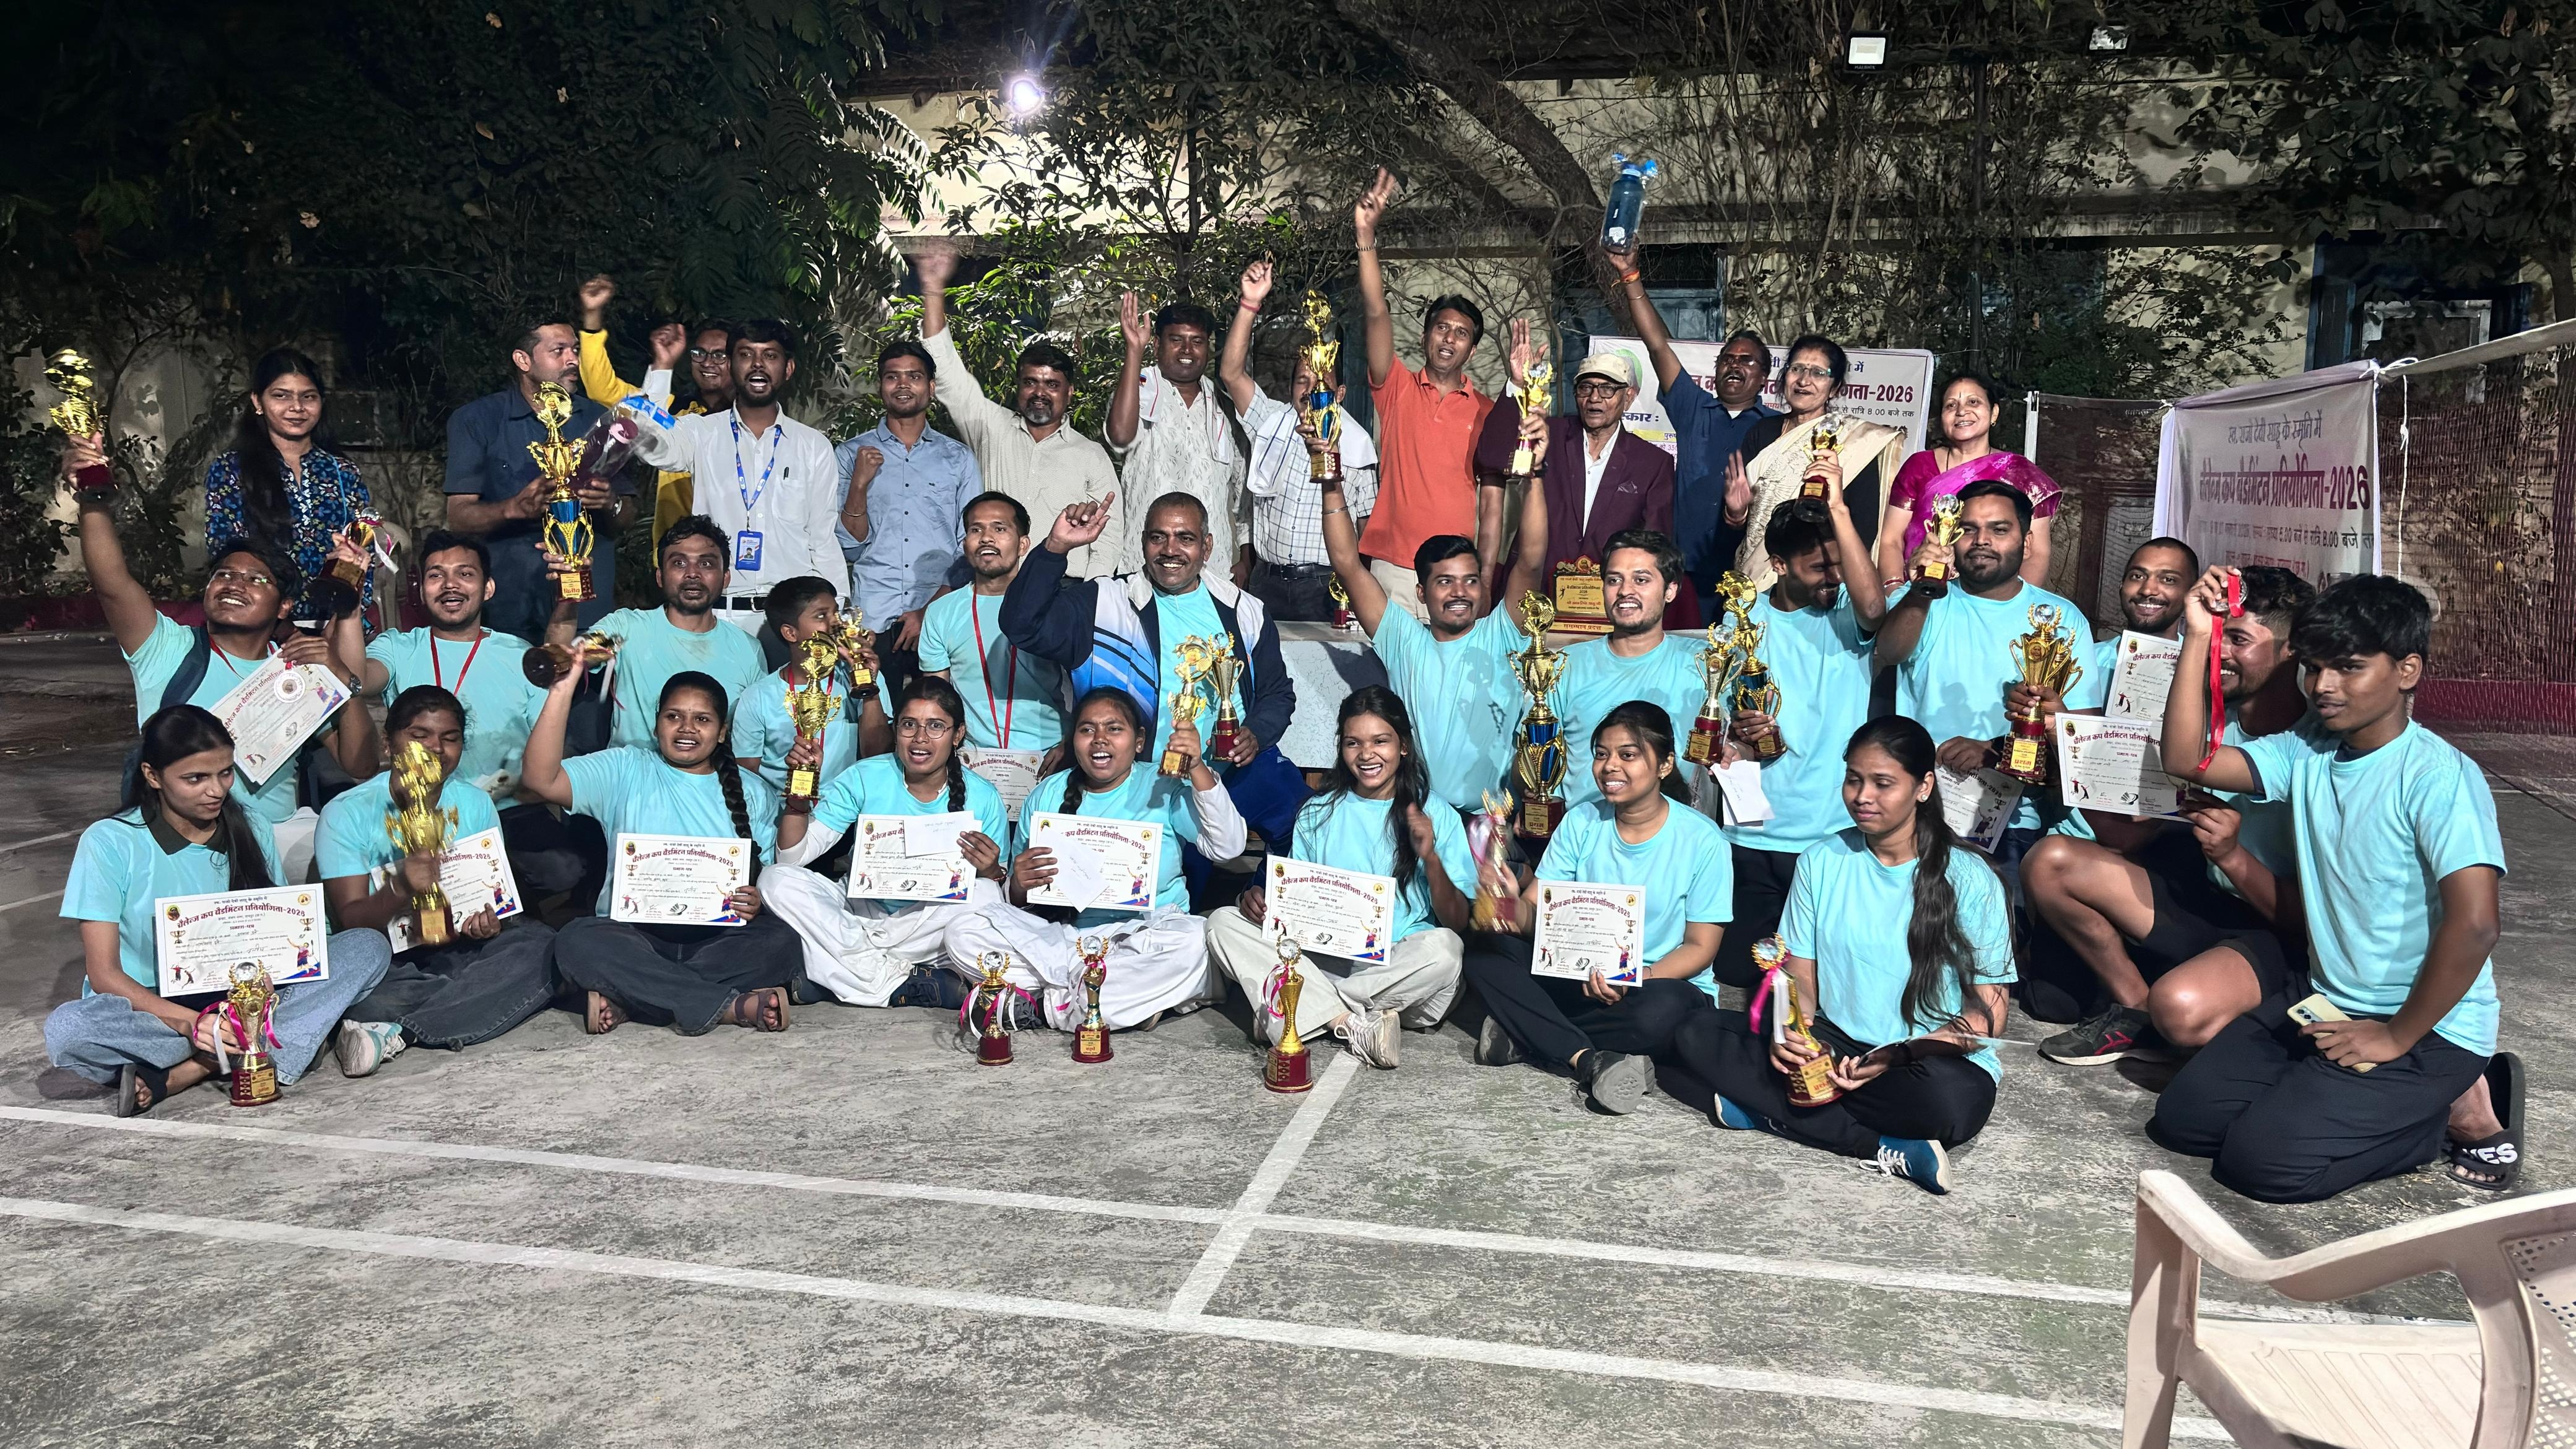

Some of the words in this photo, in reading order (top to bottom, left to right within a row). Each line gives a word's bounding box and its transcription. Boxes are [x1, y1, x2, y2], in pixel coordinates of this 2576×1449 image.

[1854, 361, 1864, 372] में
[1888, 407, 1899, 417] बजे
[2341, 526, 2359, 549] बजे
[201, 910, 214, 919] कप
